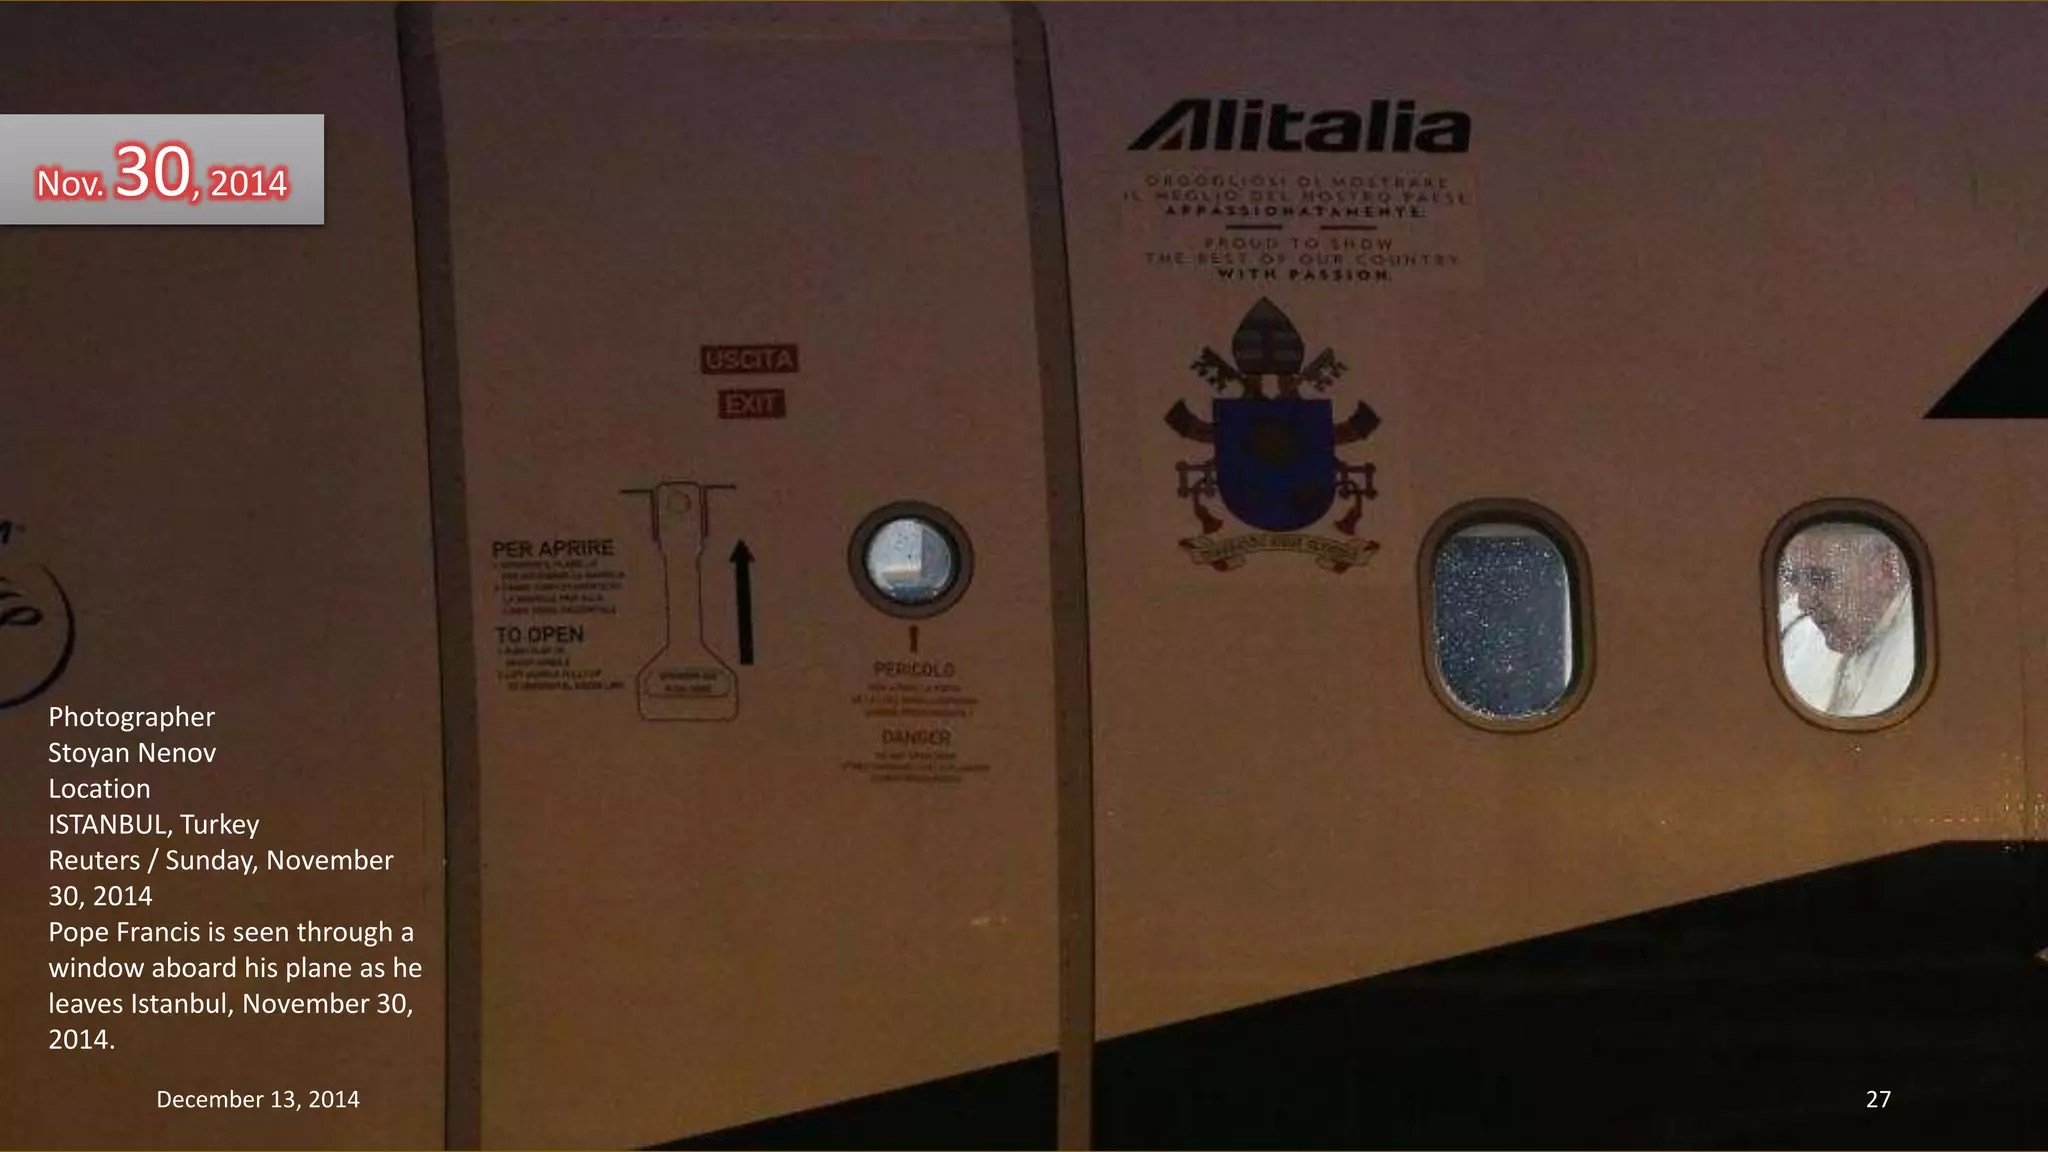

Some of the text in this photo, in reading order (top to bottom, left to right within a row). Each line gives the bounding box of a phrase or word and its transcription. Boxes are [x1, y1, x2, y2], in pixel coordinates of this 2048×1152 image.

[1127, 97, 1472, 153] Alitalia
[1155, 191, 1239, 203] MEGLIO
[1251, 191, 1291, 203] DEL
[1301, 191, 1391, 203] NOSTRO
[1204, 237, 1393, 250] PROUD TO SHOW
[1144, 252, 1460, 265] THE BEST OF OUR COUNTRY
[1217, 269, 1277, 282] WITH
[705, 348, 794, 370] USCITA
[725, 393, 777, 414] EXIT
[491, 538, 615, 558] PER APRIRE
[495, 625, 585, 643] TO OPEN
[872, 661, 957, 678] PERICOLO
[881, 729, 952, 746] DANGER
